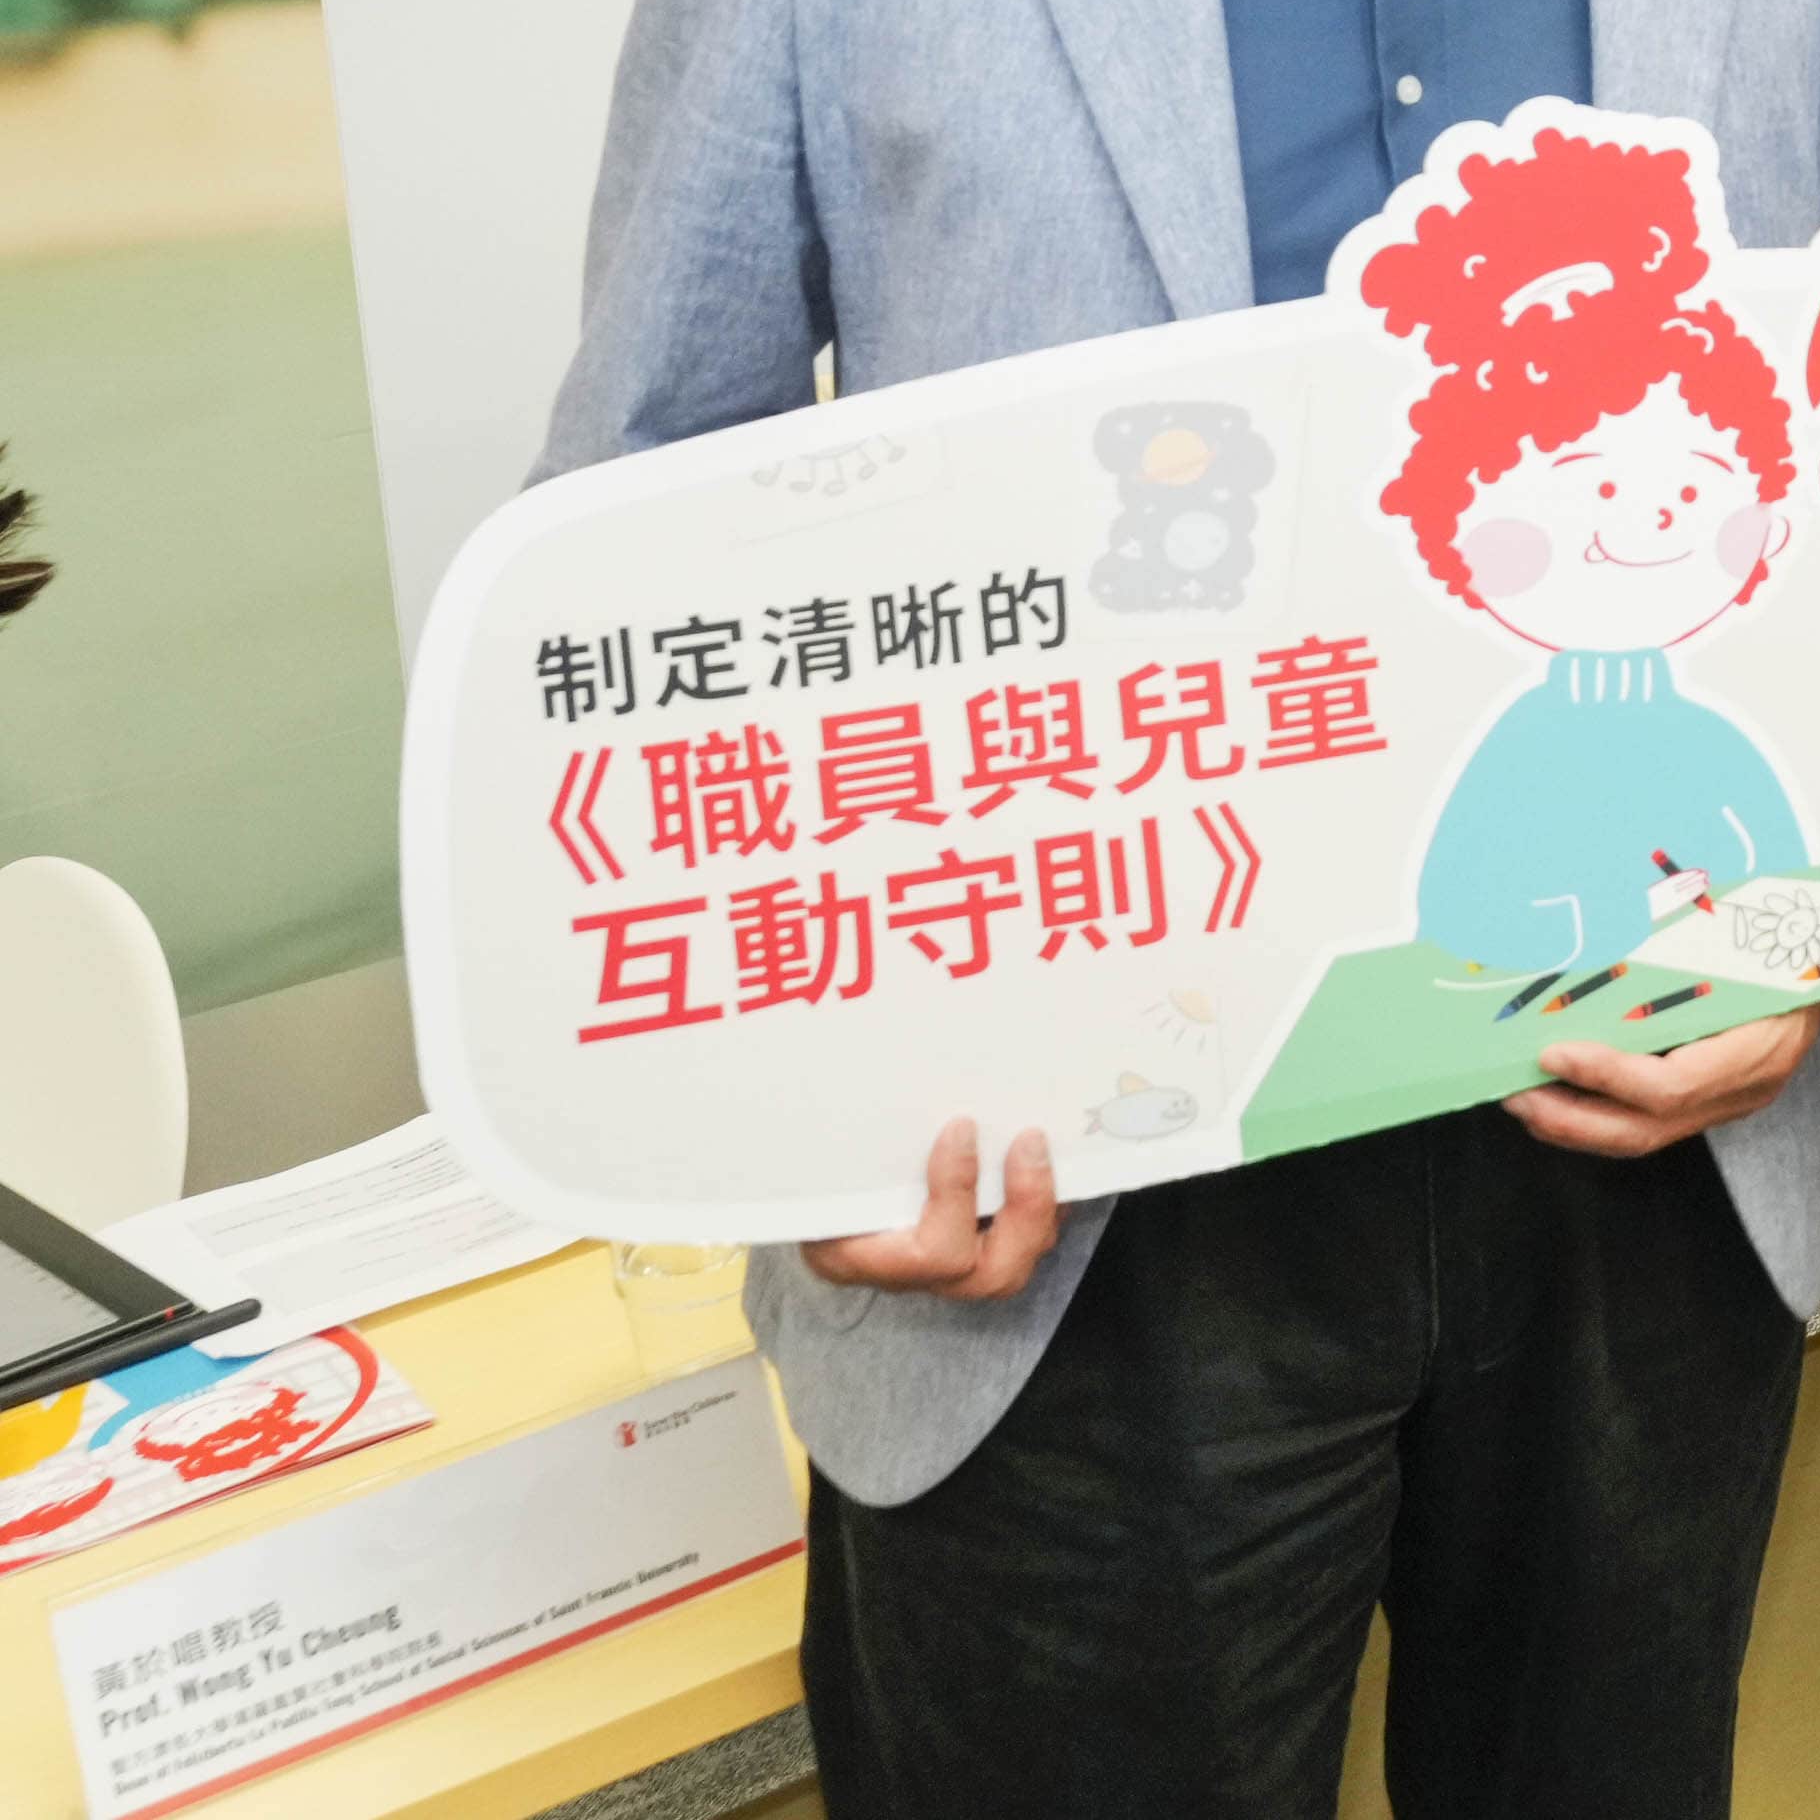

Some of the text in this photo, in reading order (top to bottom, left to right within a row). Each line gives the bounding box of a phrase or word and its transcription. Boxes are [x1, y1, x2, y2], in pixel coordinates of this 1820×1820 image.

[536, 566, 1071, 724] 制定清晰的
[548, 633, 1390, 887] 《職員與兒童
[570, 800, 1262, 1045] 互動守則》
